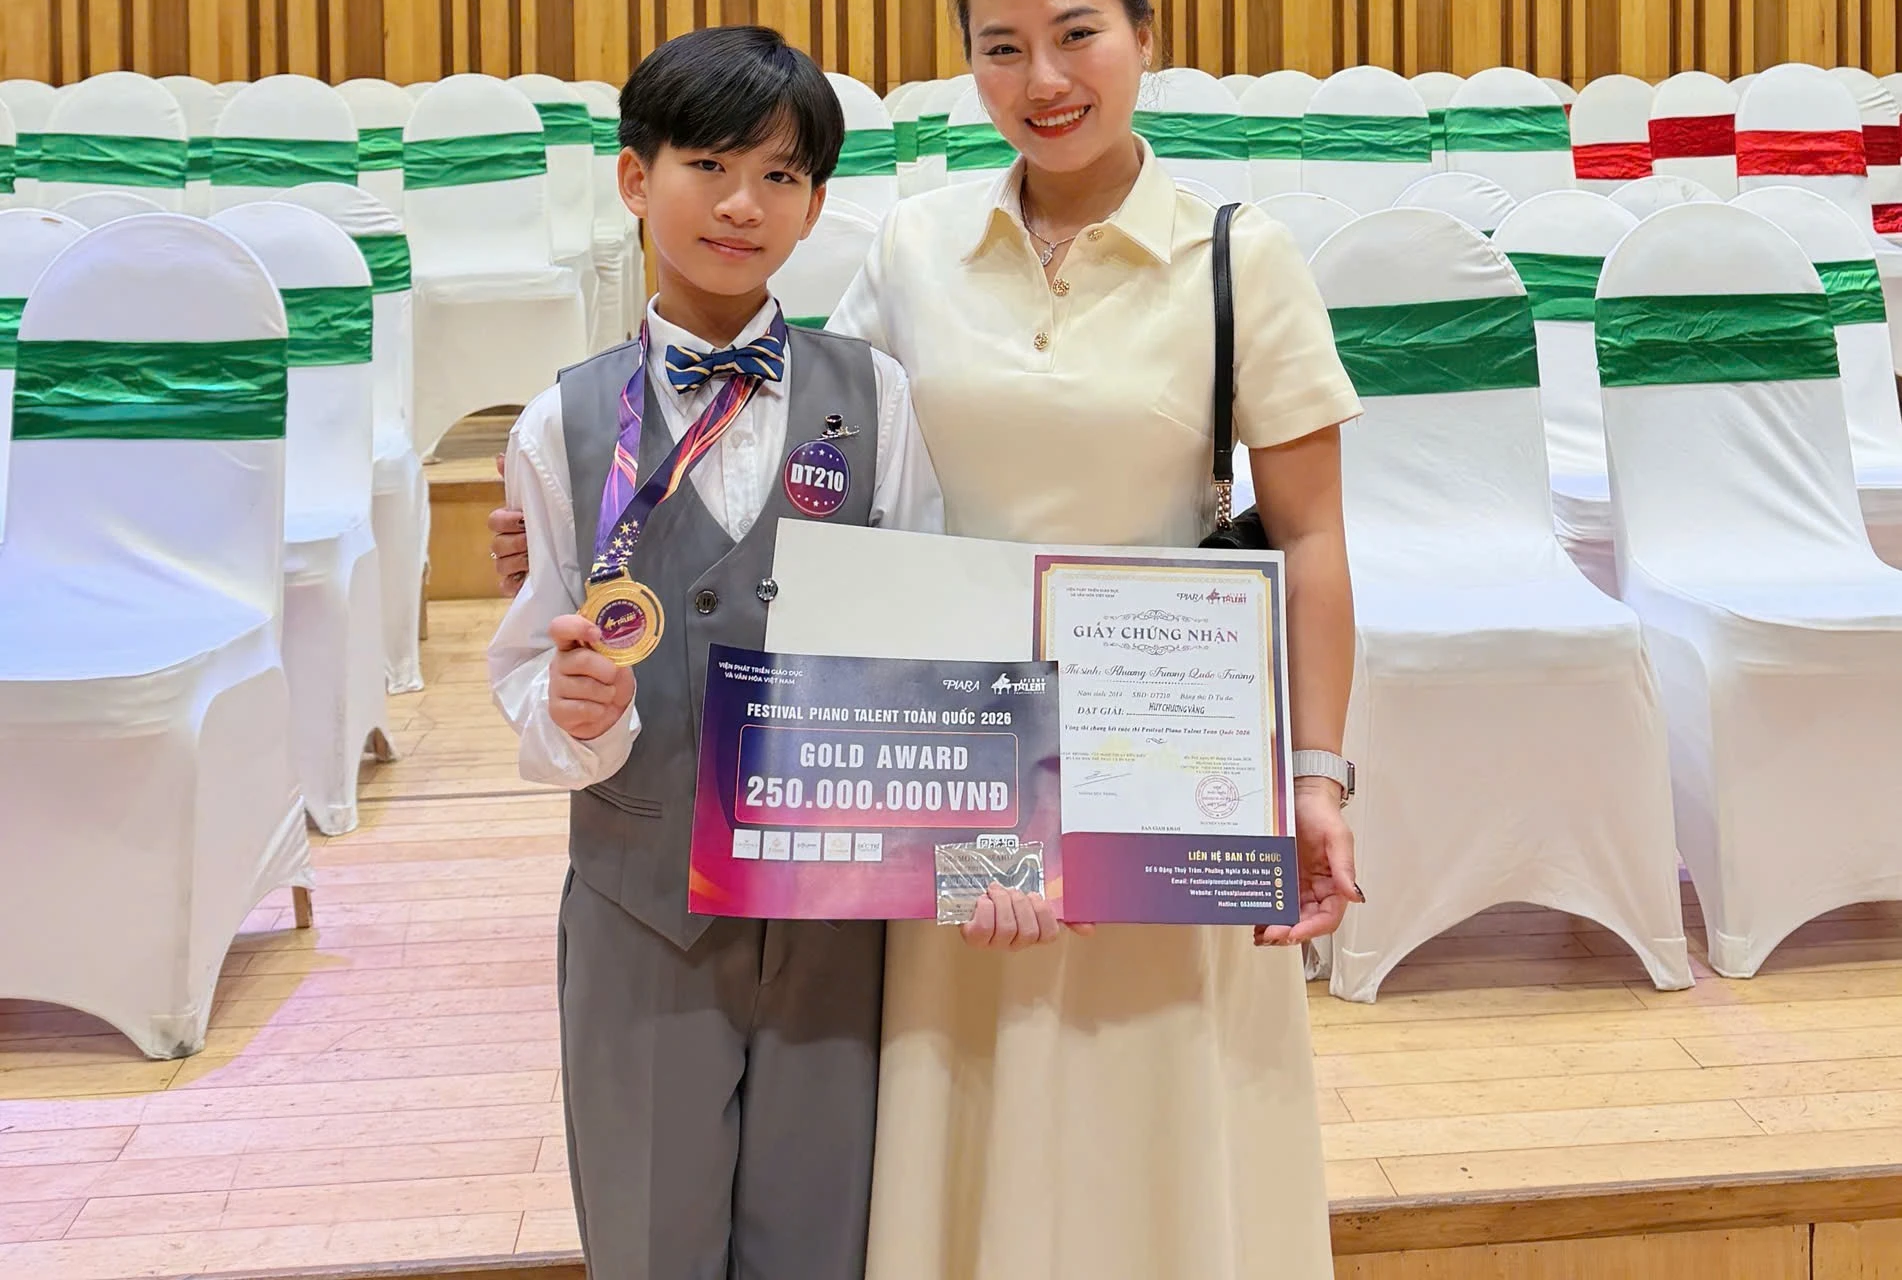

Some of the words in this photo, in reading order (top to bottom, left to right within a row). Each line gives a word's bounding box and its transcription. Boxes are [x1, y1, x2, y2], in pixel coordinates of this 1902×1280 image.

[789, 462, 846, 494] DT210
[1073, 621, 1116, 639] GIẤY
[1121, 624, 1182, 641] CHỨNG
[1187, 627, 1239, 644] NHẬN
[942, 679, 980, 694] PIARA
[747, 702, 804, 719] FESTIVAL
[809, 707, 849, 722] PIANO
[854, 708, 899, 722] TALENT
[903, 707, 937, 724] TOÀN
[942, 706, 976, 726] QUỐC
[980, 711, 1012, 725] 2026
[799, 742, 864, 769] GOLD
[876, 745, 969, 771] AWARD
[1188, 849, 1208, 861] LIÊN
[1210, 850, 1222, 863] HỆ
[1225, 851, 1243, 862] BAN
